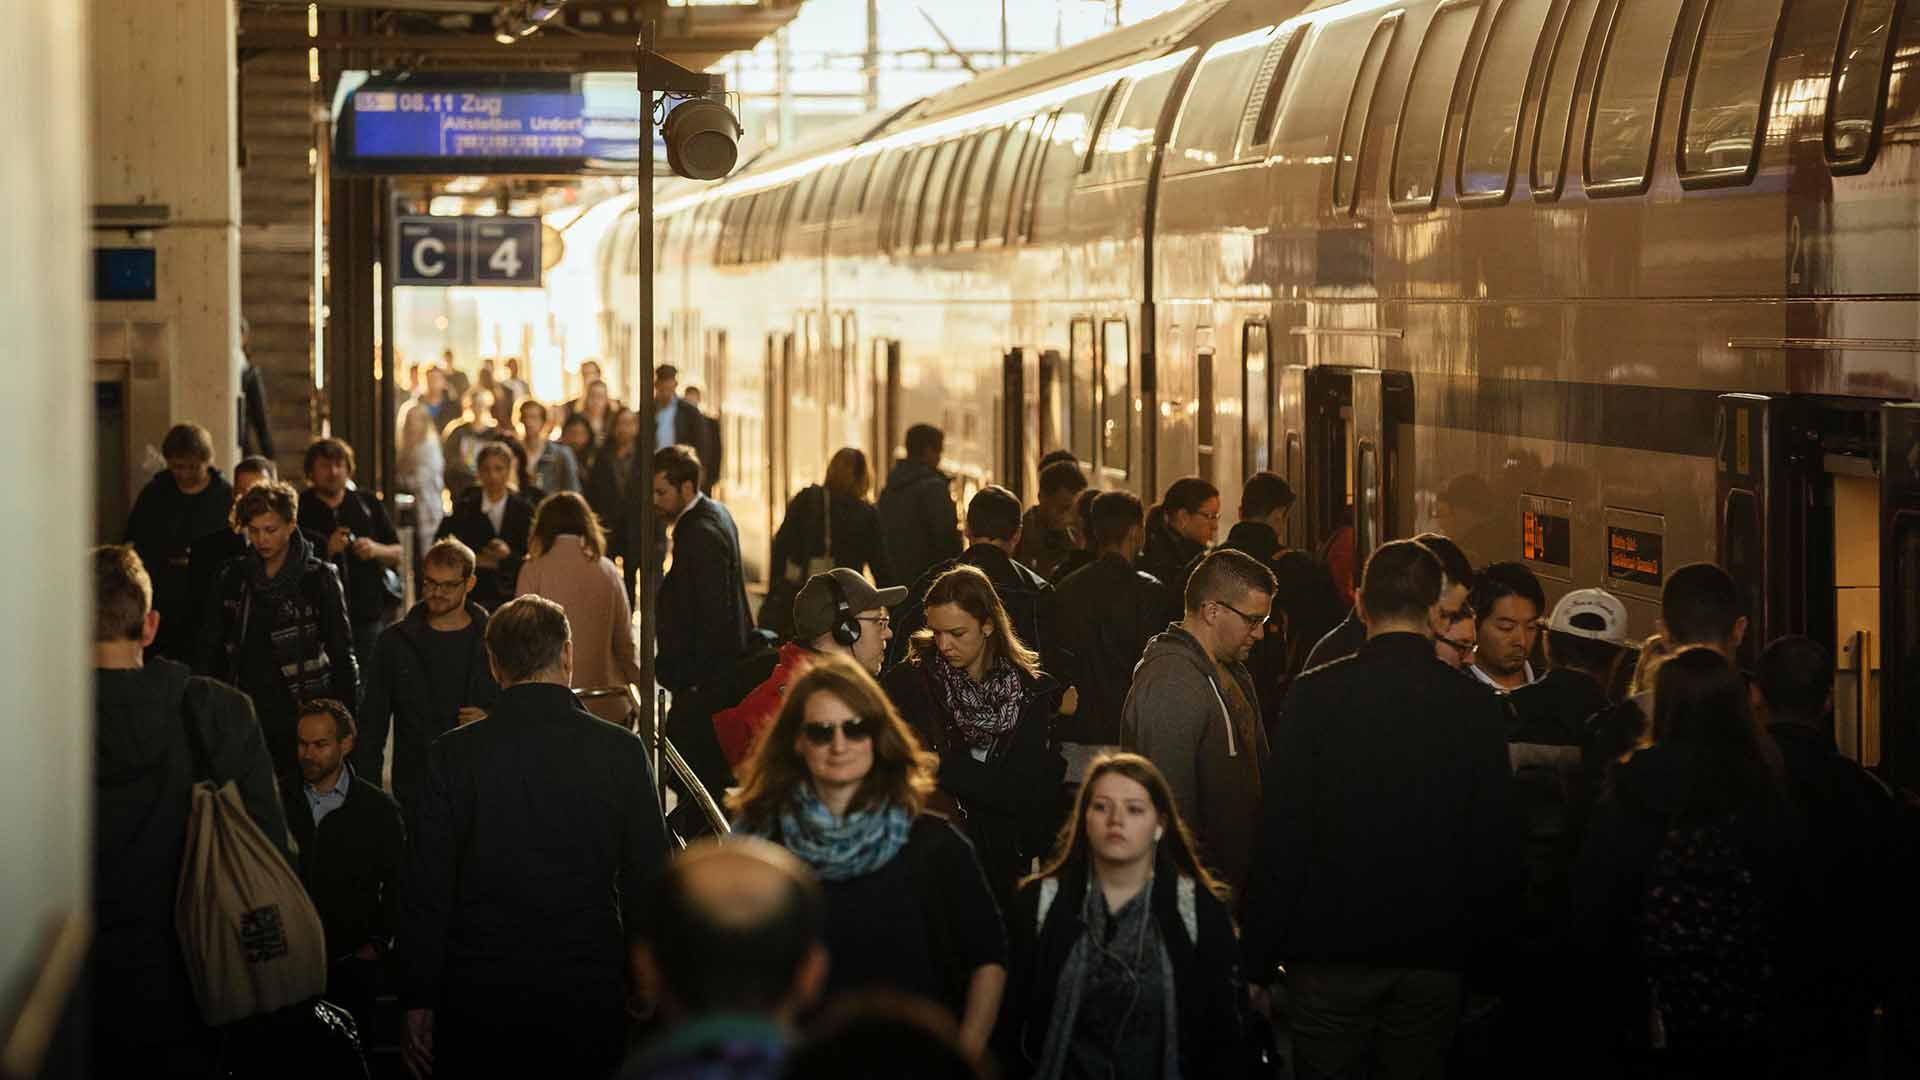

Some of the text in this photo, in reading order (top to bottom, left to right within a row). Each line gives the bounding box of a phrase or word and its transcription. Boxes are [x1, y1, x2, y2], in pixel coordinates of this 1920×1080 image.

[399, 93, 454, 113] 08.11
[461, 93, 502, 117] Zug
[413, 237, 446, 278] C
[490, 237, 523, 278] 4
[1791, 215, 1801, 285] 2
